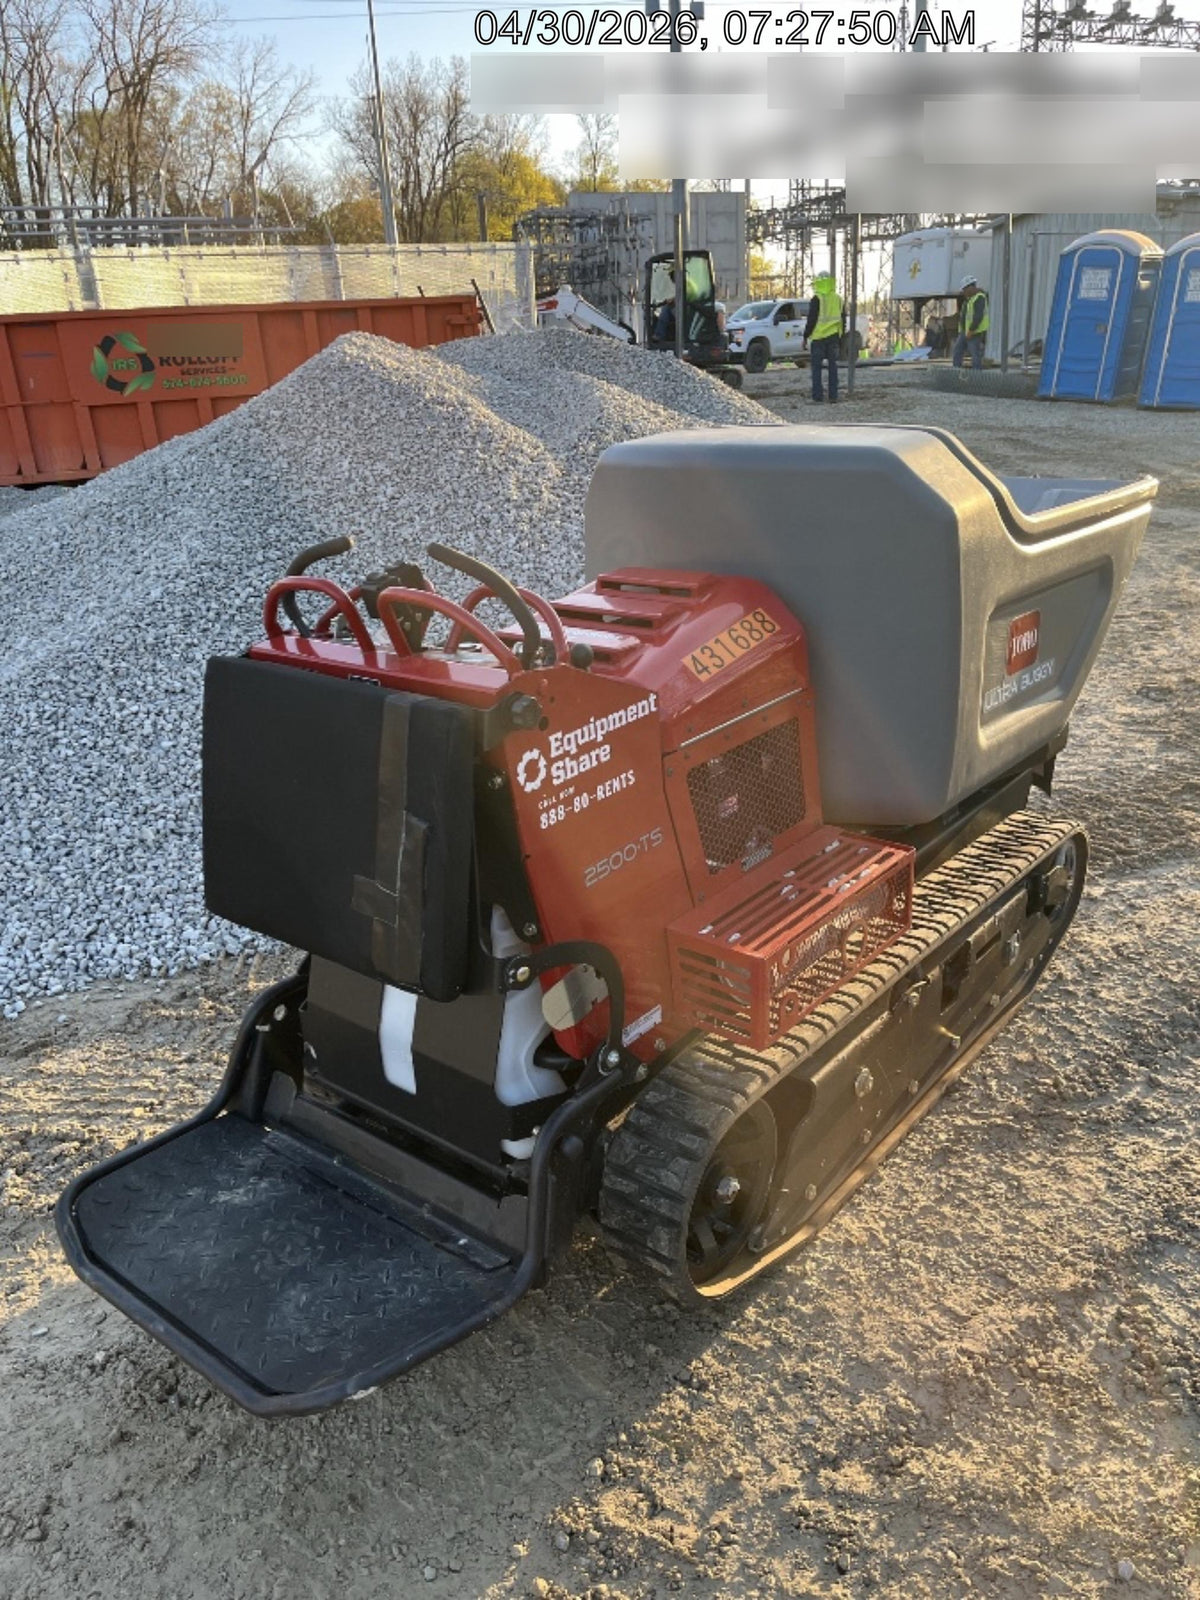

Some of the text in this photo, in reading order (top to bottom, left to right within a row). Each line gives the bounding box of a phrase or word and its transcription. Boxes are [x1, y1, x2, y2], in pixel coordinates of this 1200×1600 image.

[113, 359, 137, 371] IRS
[688, 610, 778, 680] 431688
[548, 692, 658, 759] Equipment
[550, 743, 612, 787] Share
[539, 769, 636, 830] 888-80-RENTS
